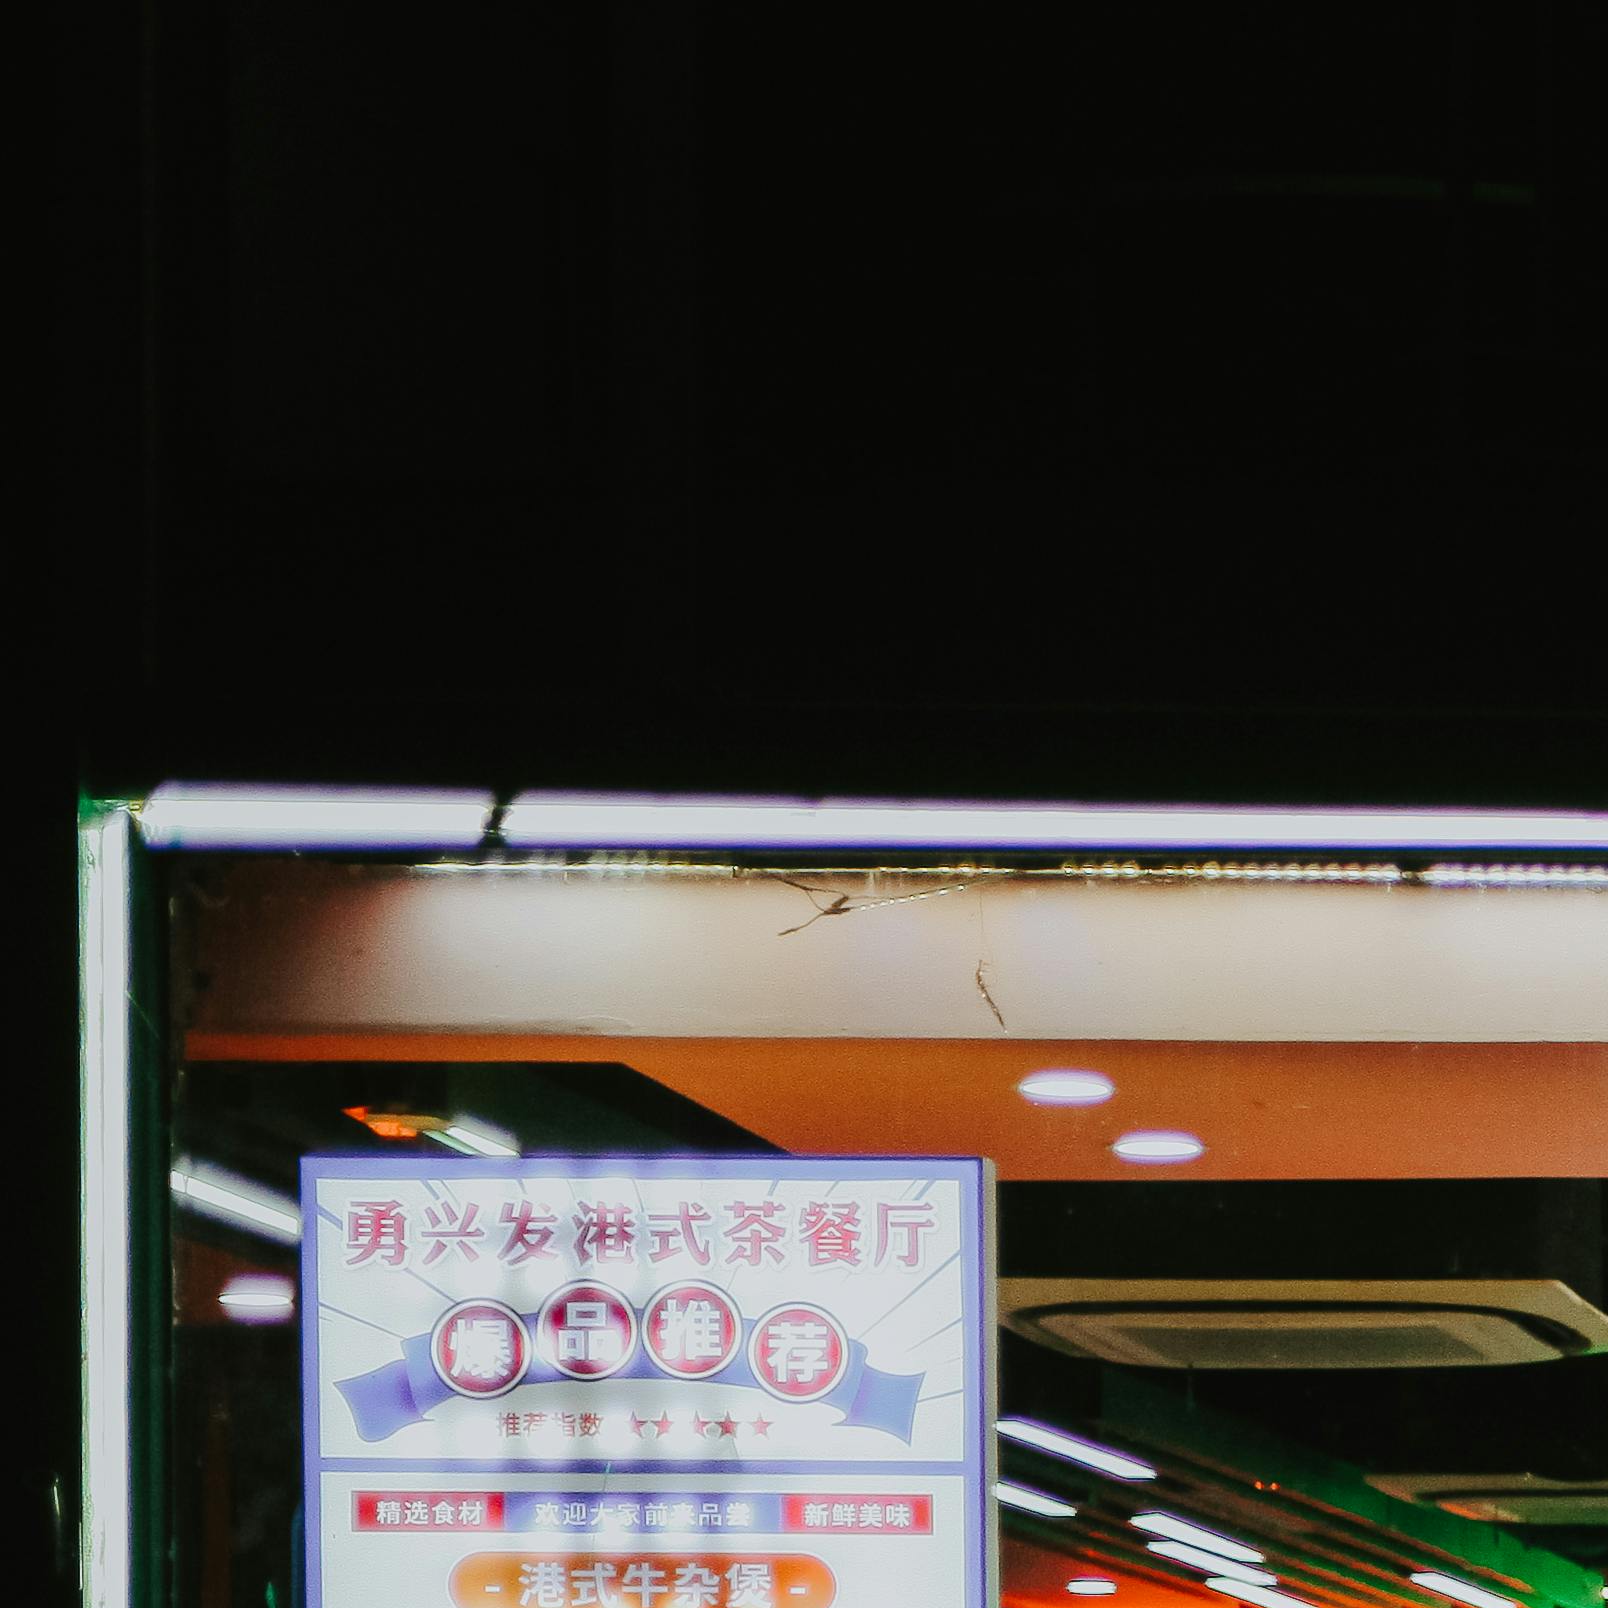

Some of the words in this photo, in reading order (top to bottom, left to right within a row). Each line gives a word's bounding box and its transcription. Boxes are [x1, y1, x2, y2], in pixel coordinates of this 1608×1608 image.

[345, 1200, 935, 1267] 勇兴发港式茶餐厅
[449, 1299, 829, 1384] 爆品推荐
[497, 1411, 602, 1439] 推荐指数
[376, 1499, 485, 1527] 精选食材
[535, 1502, 752, 1529] 欢迎大家前来品尝
[804, 1502, 911, 1529] 新鲜美味
